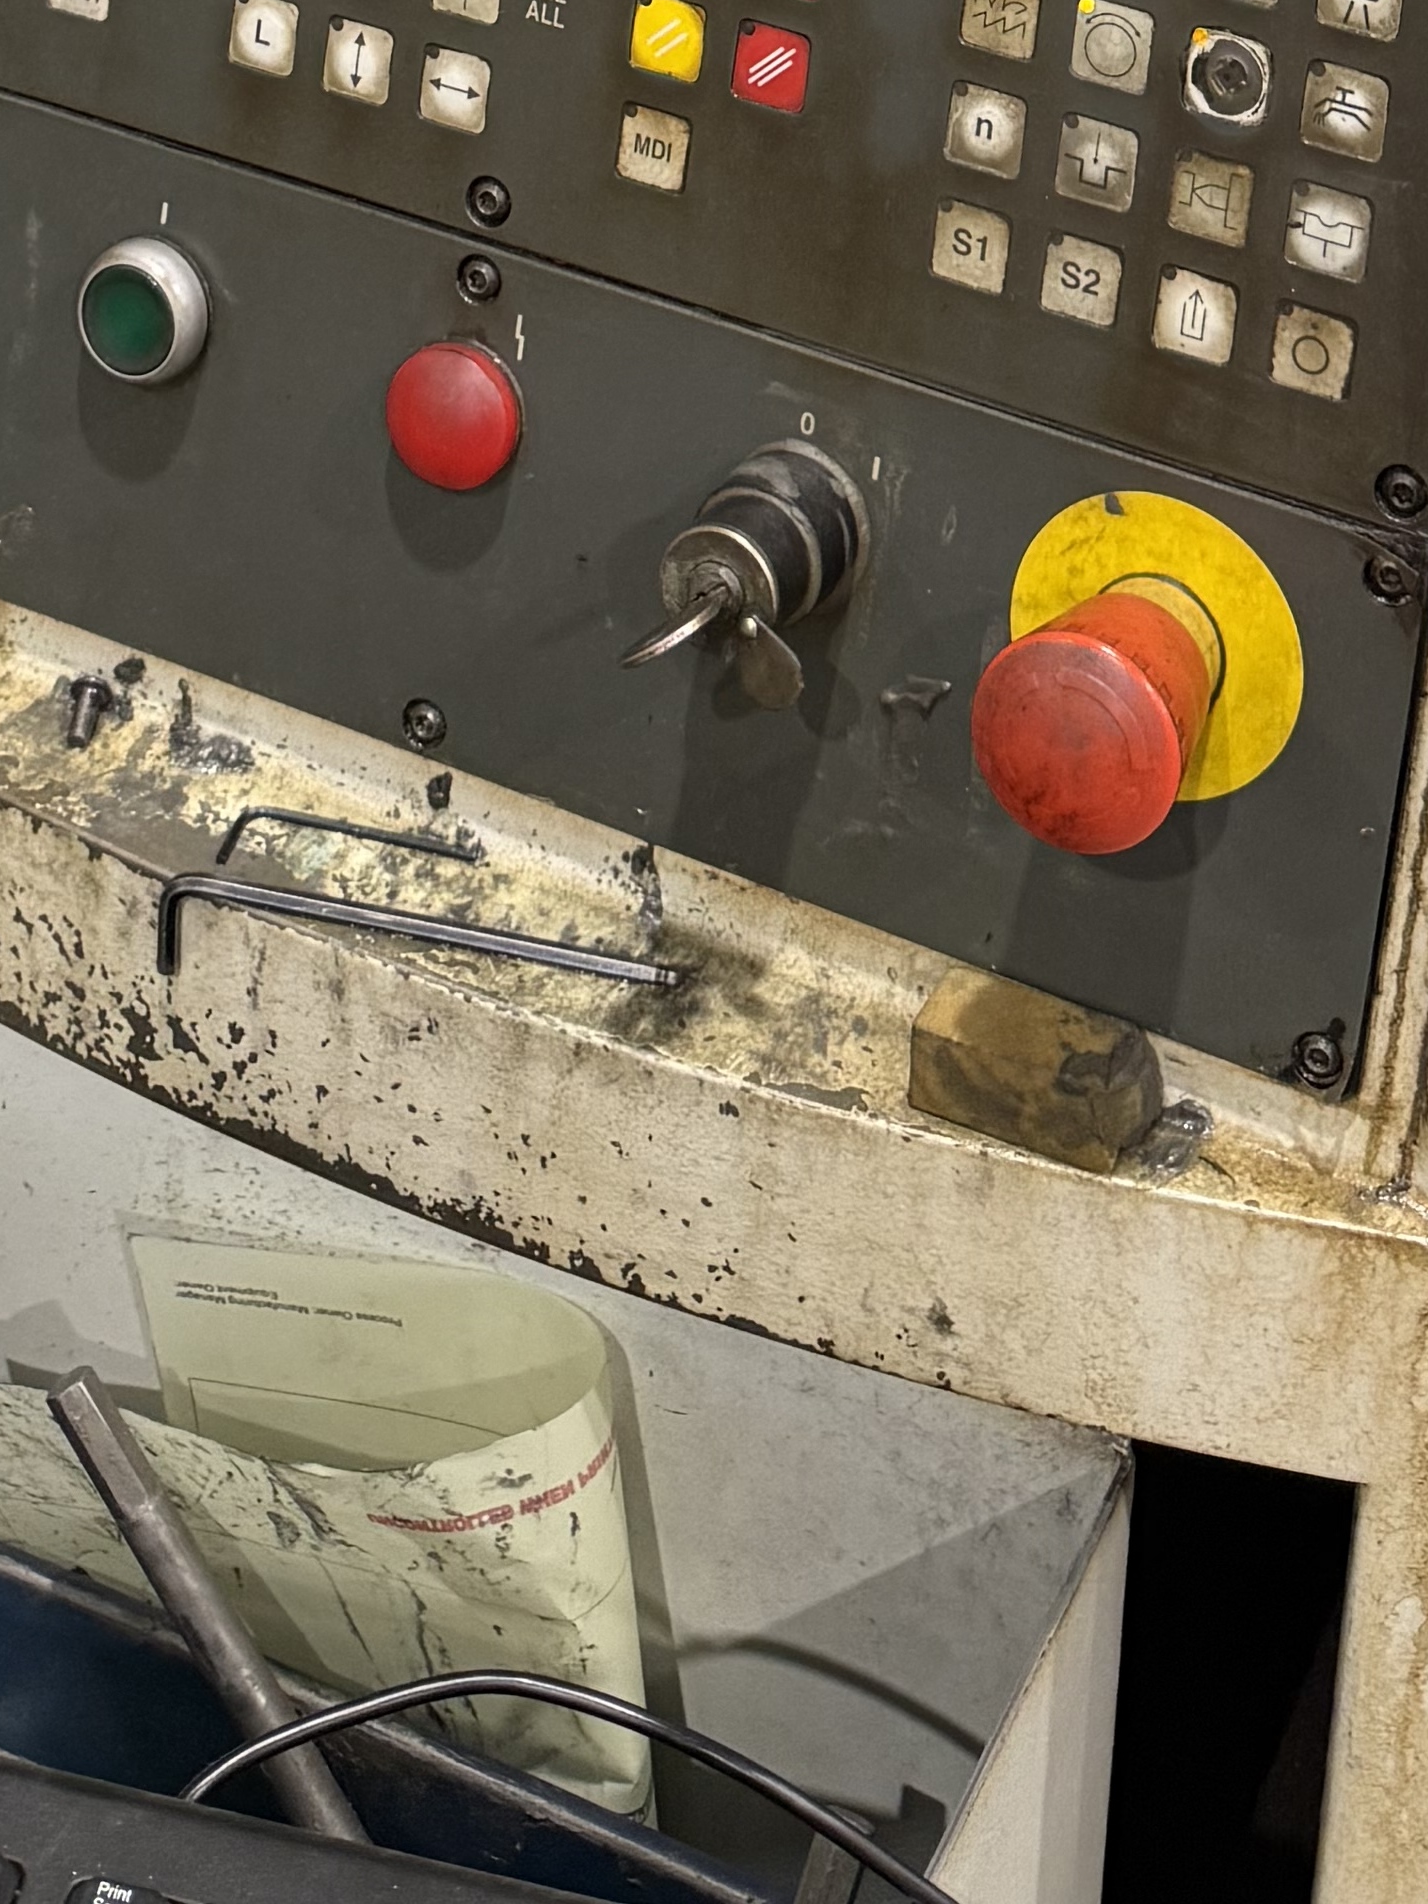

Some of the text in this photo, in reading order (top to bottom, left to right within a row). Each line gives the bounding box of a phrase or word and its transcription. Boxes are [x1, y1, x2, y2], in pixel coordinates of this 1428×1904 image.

[525, 0, 565, 29] ALL
[633, 133, 672, 163] MDI
[952, 228, 1101, 295] S1 S2
